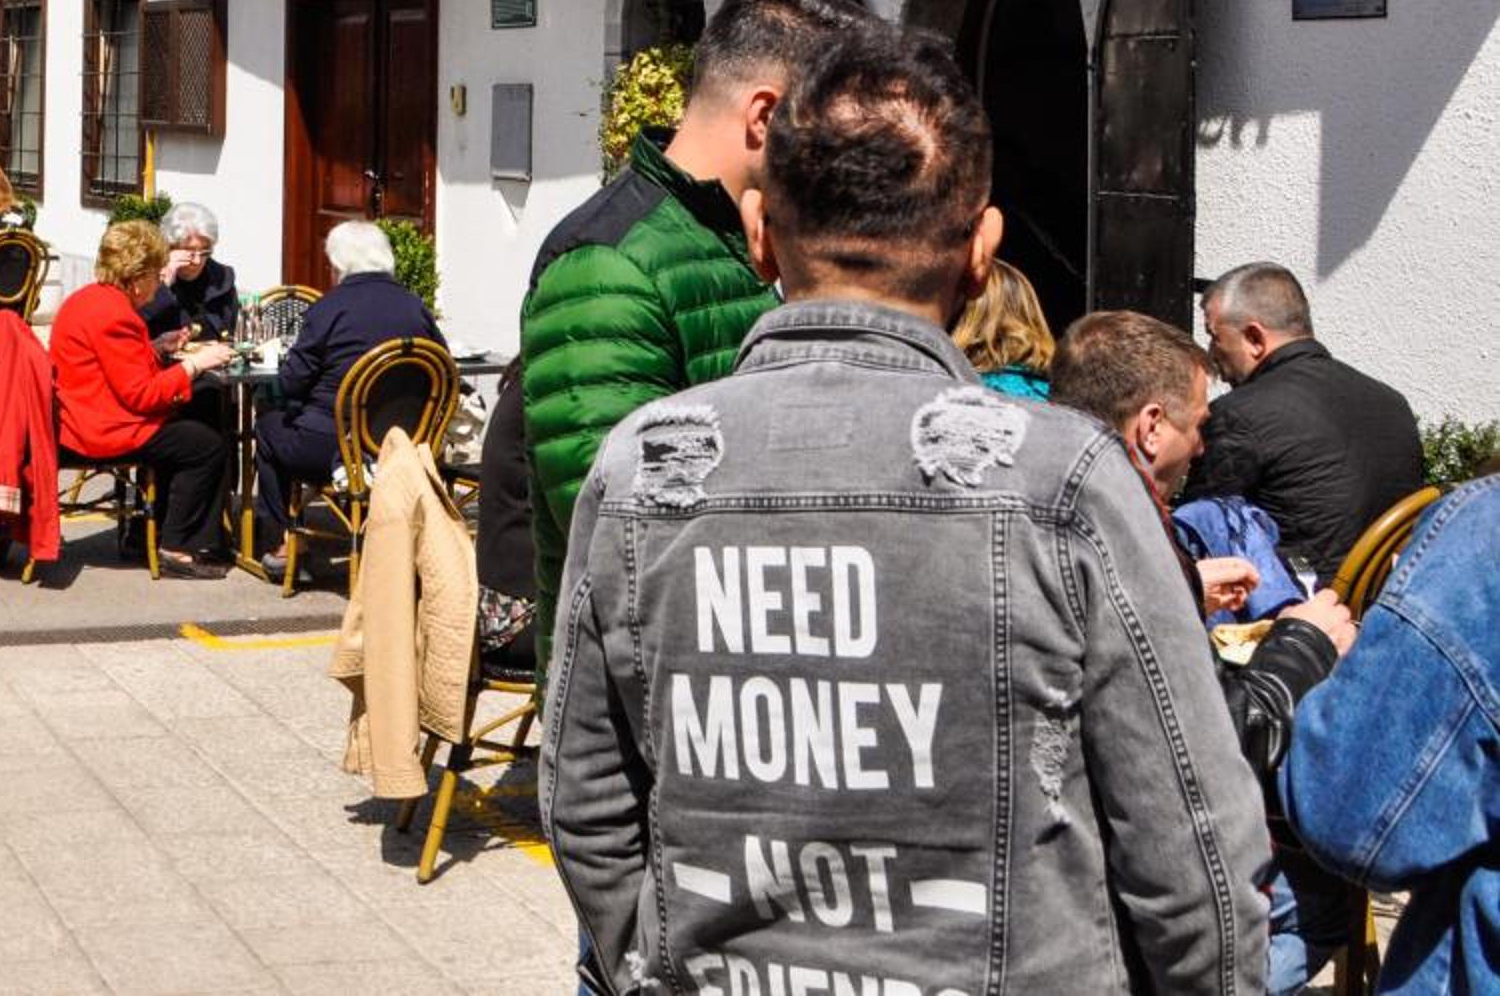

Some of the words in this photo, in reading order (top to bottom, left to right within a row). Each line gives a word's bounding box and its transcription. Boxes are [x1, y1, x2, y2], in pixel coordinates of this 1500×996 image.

[694, 545, 879, 659] NEED
[671, 673, 943, 789] MONEY
[744, 834, 898, 933] NOT
